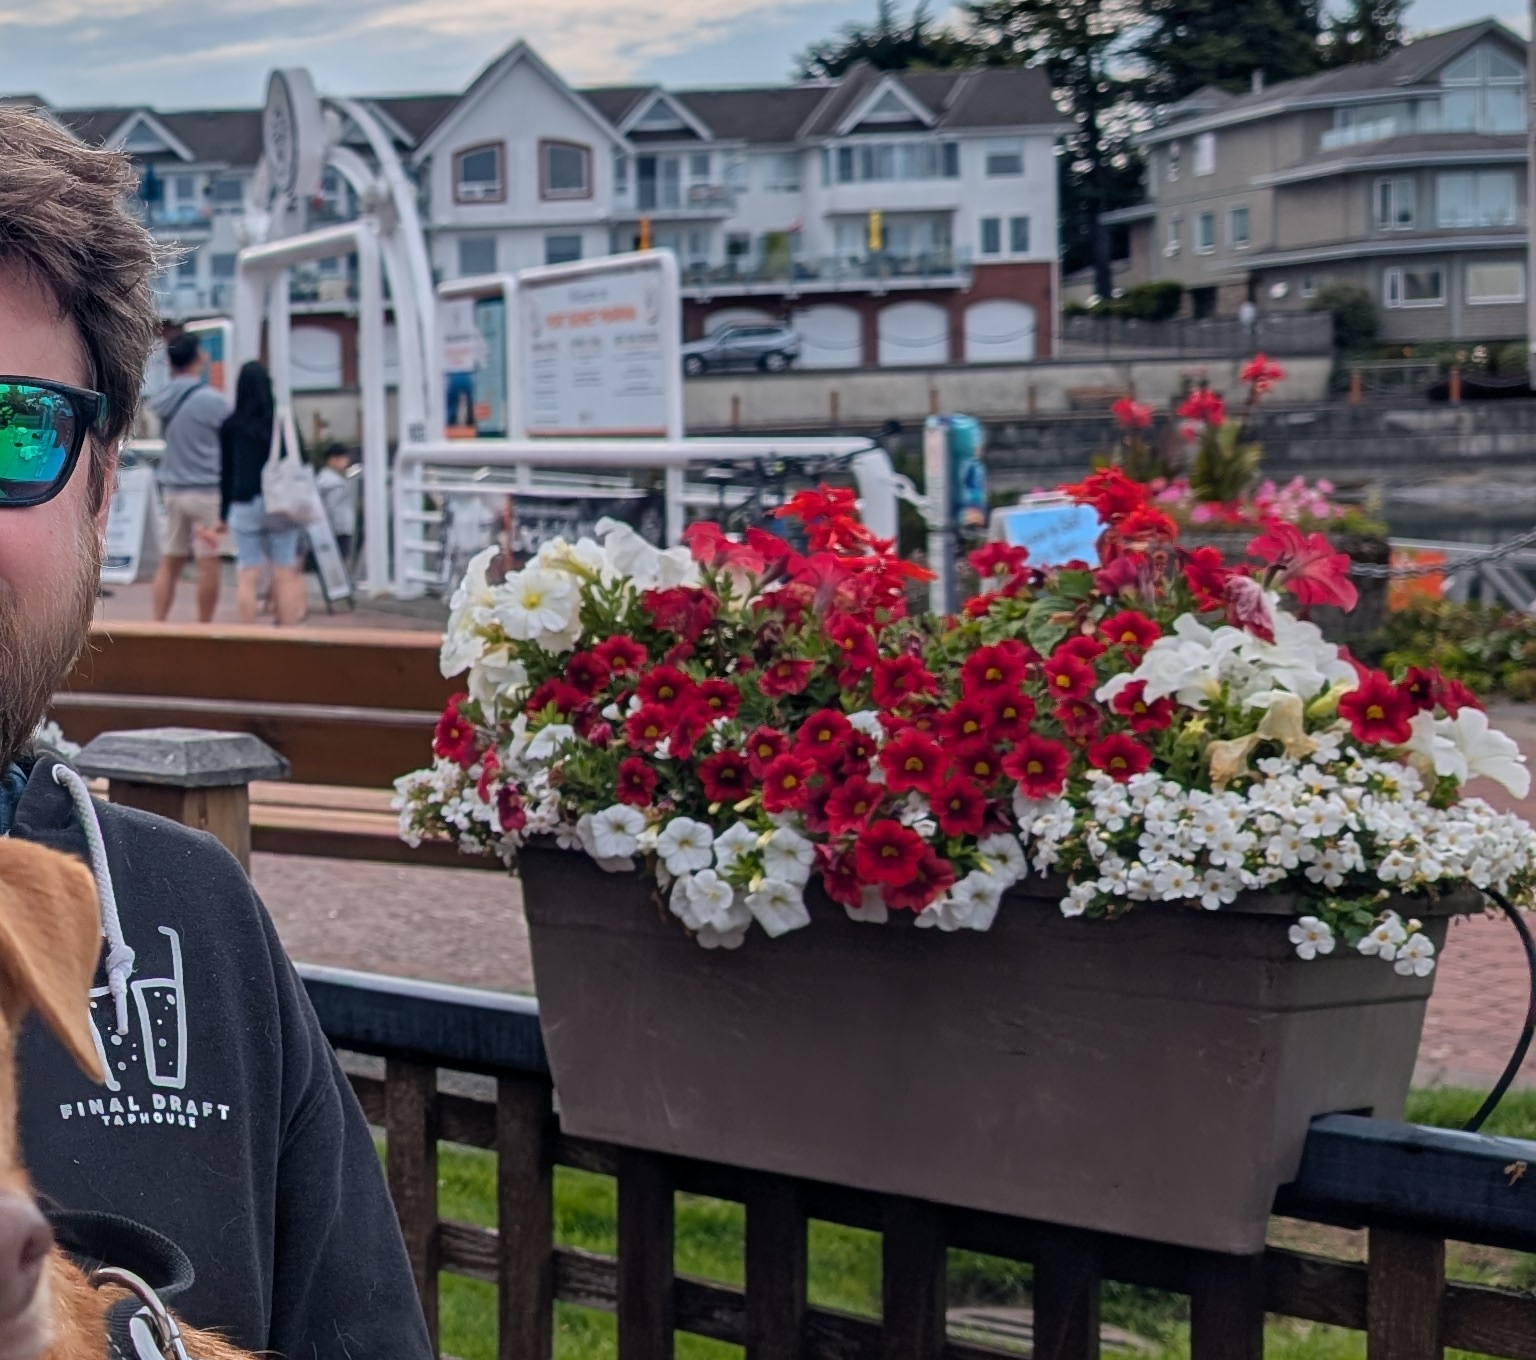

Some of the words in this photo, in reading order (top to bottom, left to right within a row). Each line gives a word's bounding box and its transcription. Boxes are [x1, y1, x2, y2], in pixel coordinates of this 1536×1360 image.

[59, 1095, 141, 1120] FINAL
[151, 1092, 231, 1121] DRAFT
[100, 1110, 197, 1129] TAPHOUSE
